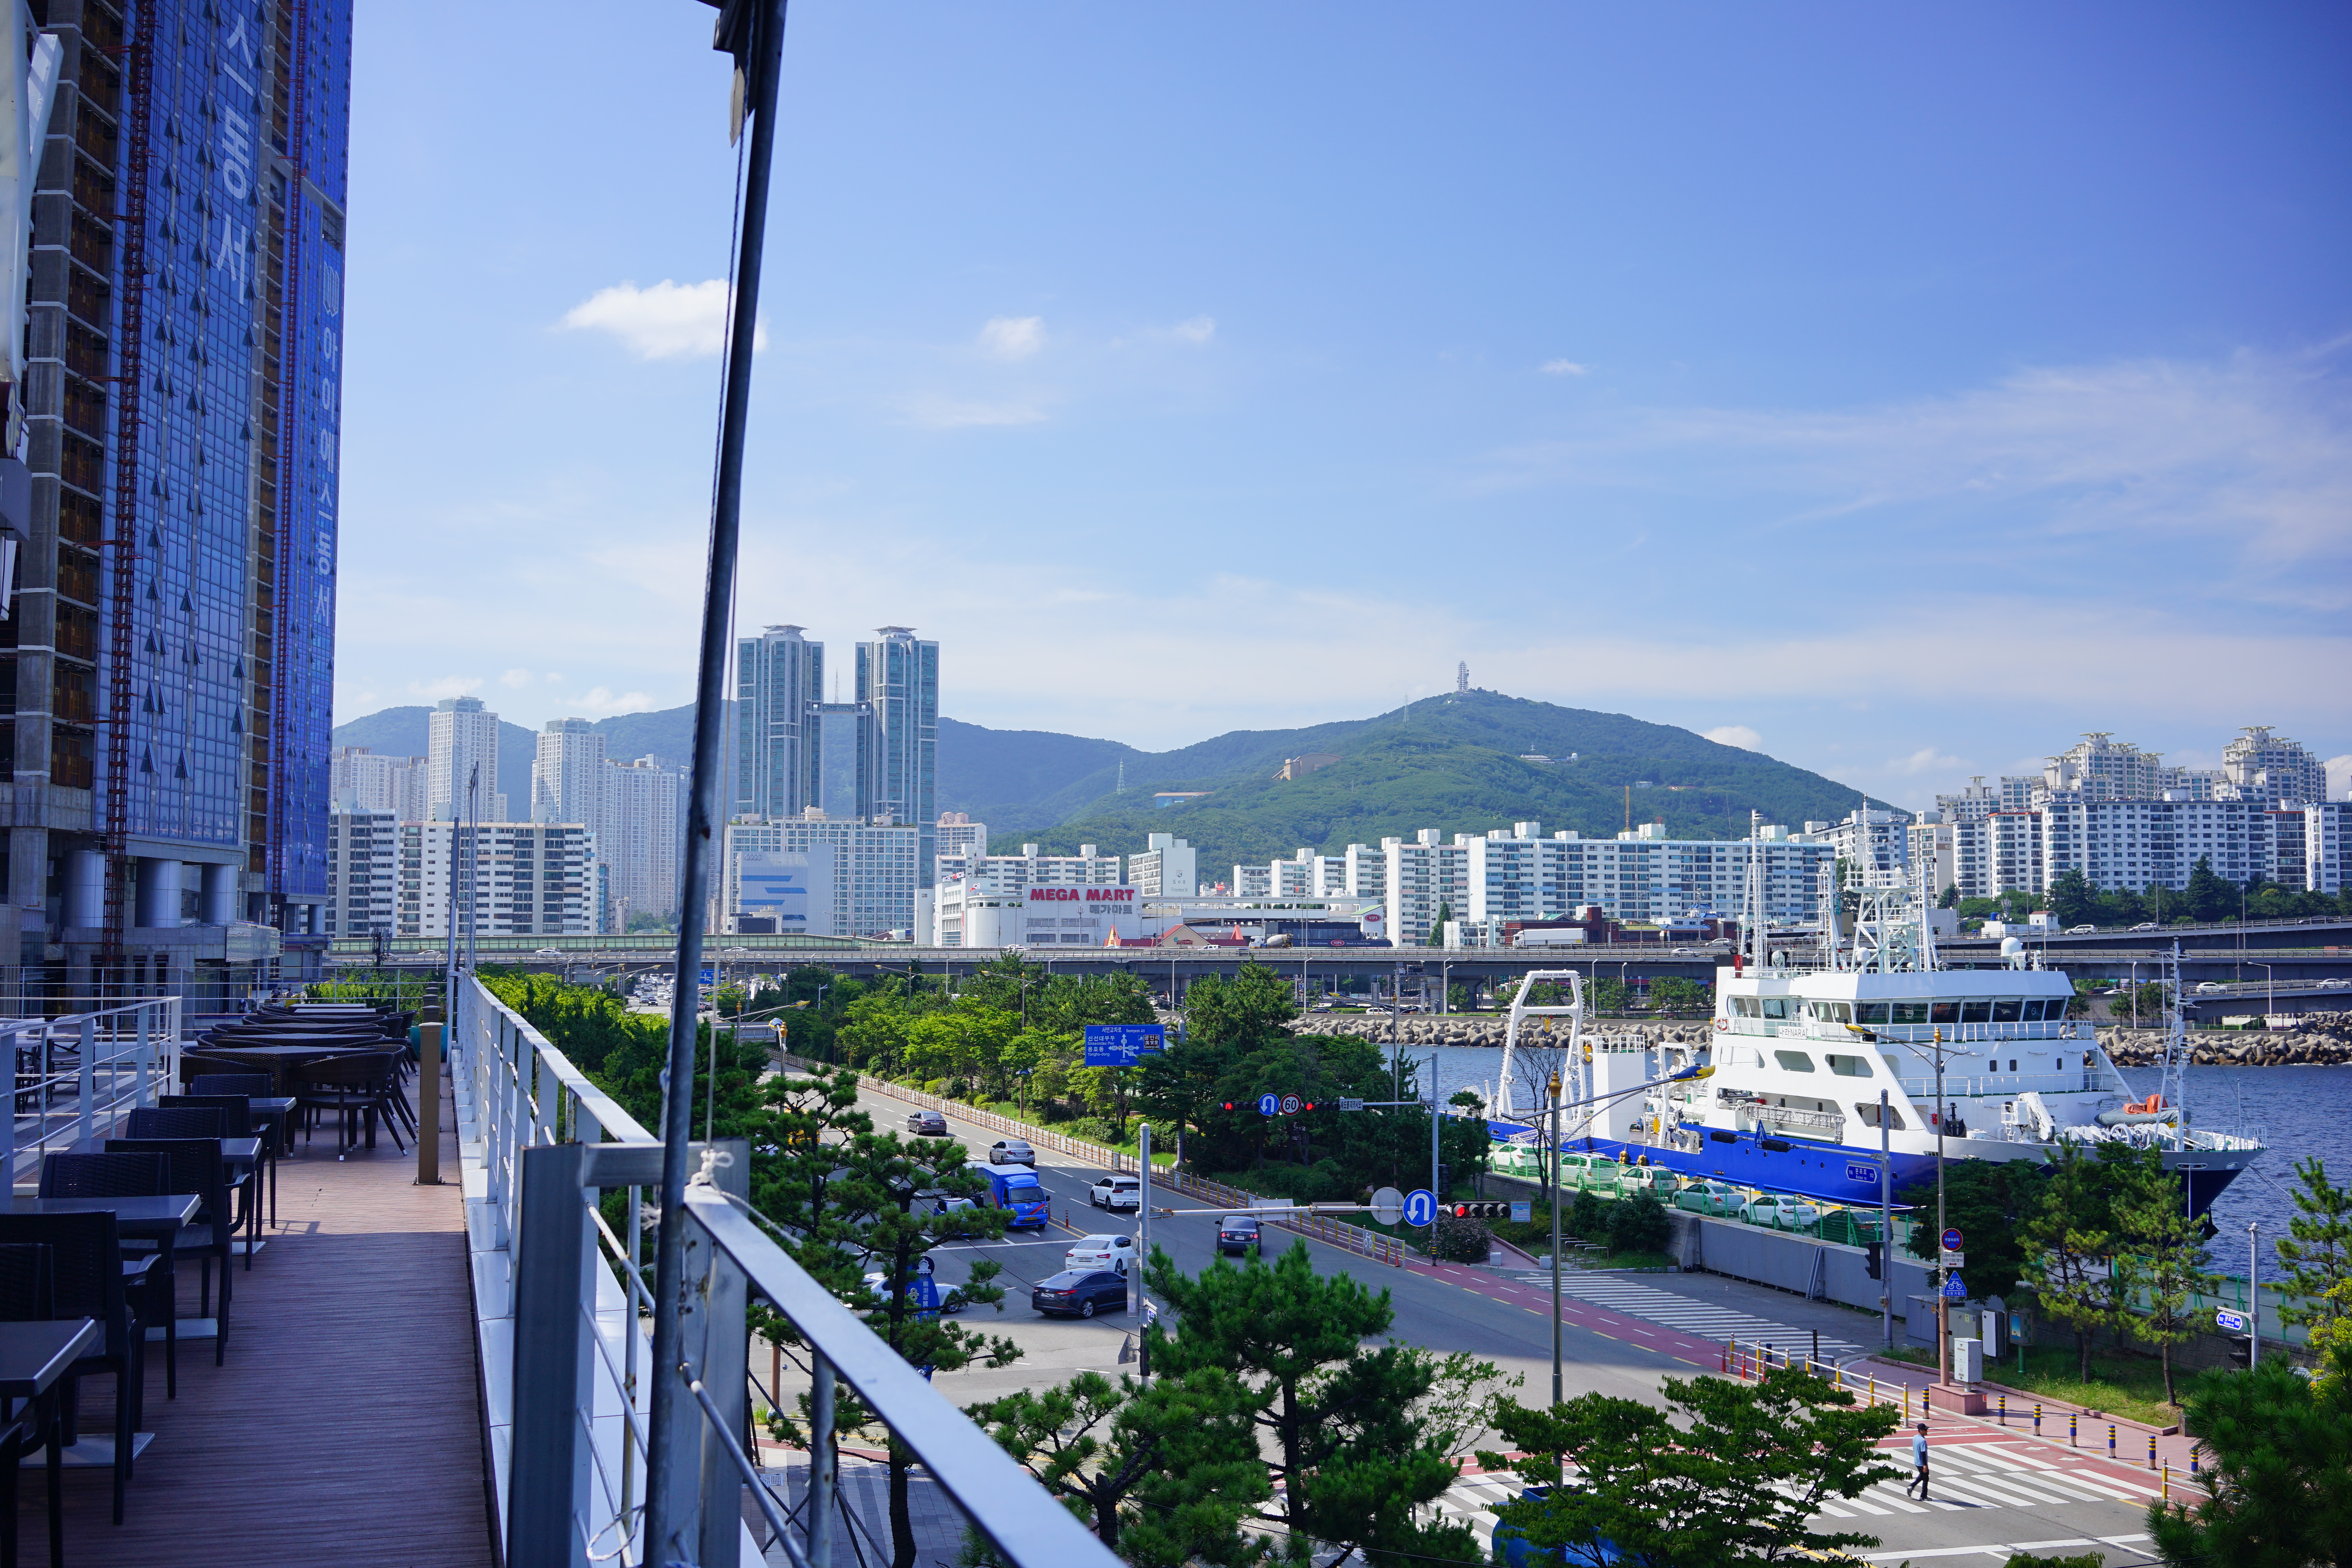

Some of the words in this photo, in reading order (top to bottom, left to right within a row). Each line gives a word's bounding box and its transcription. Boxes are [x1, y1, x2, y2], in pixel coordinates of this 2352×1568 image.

[217, 0, 257, 304] 스동서
[316, 327, 338, 627] 아이에스동서
[1030, 889, 1080, 900] MEGA
[1086, 889, 1134, 901] MART
[1089, 904, 1132, 914] 메가마트
[1285, 1100, 1296, 1110] 60
